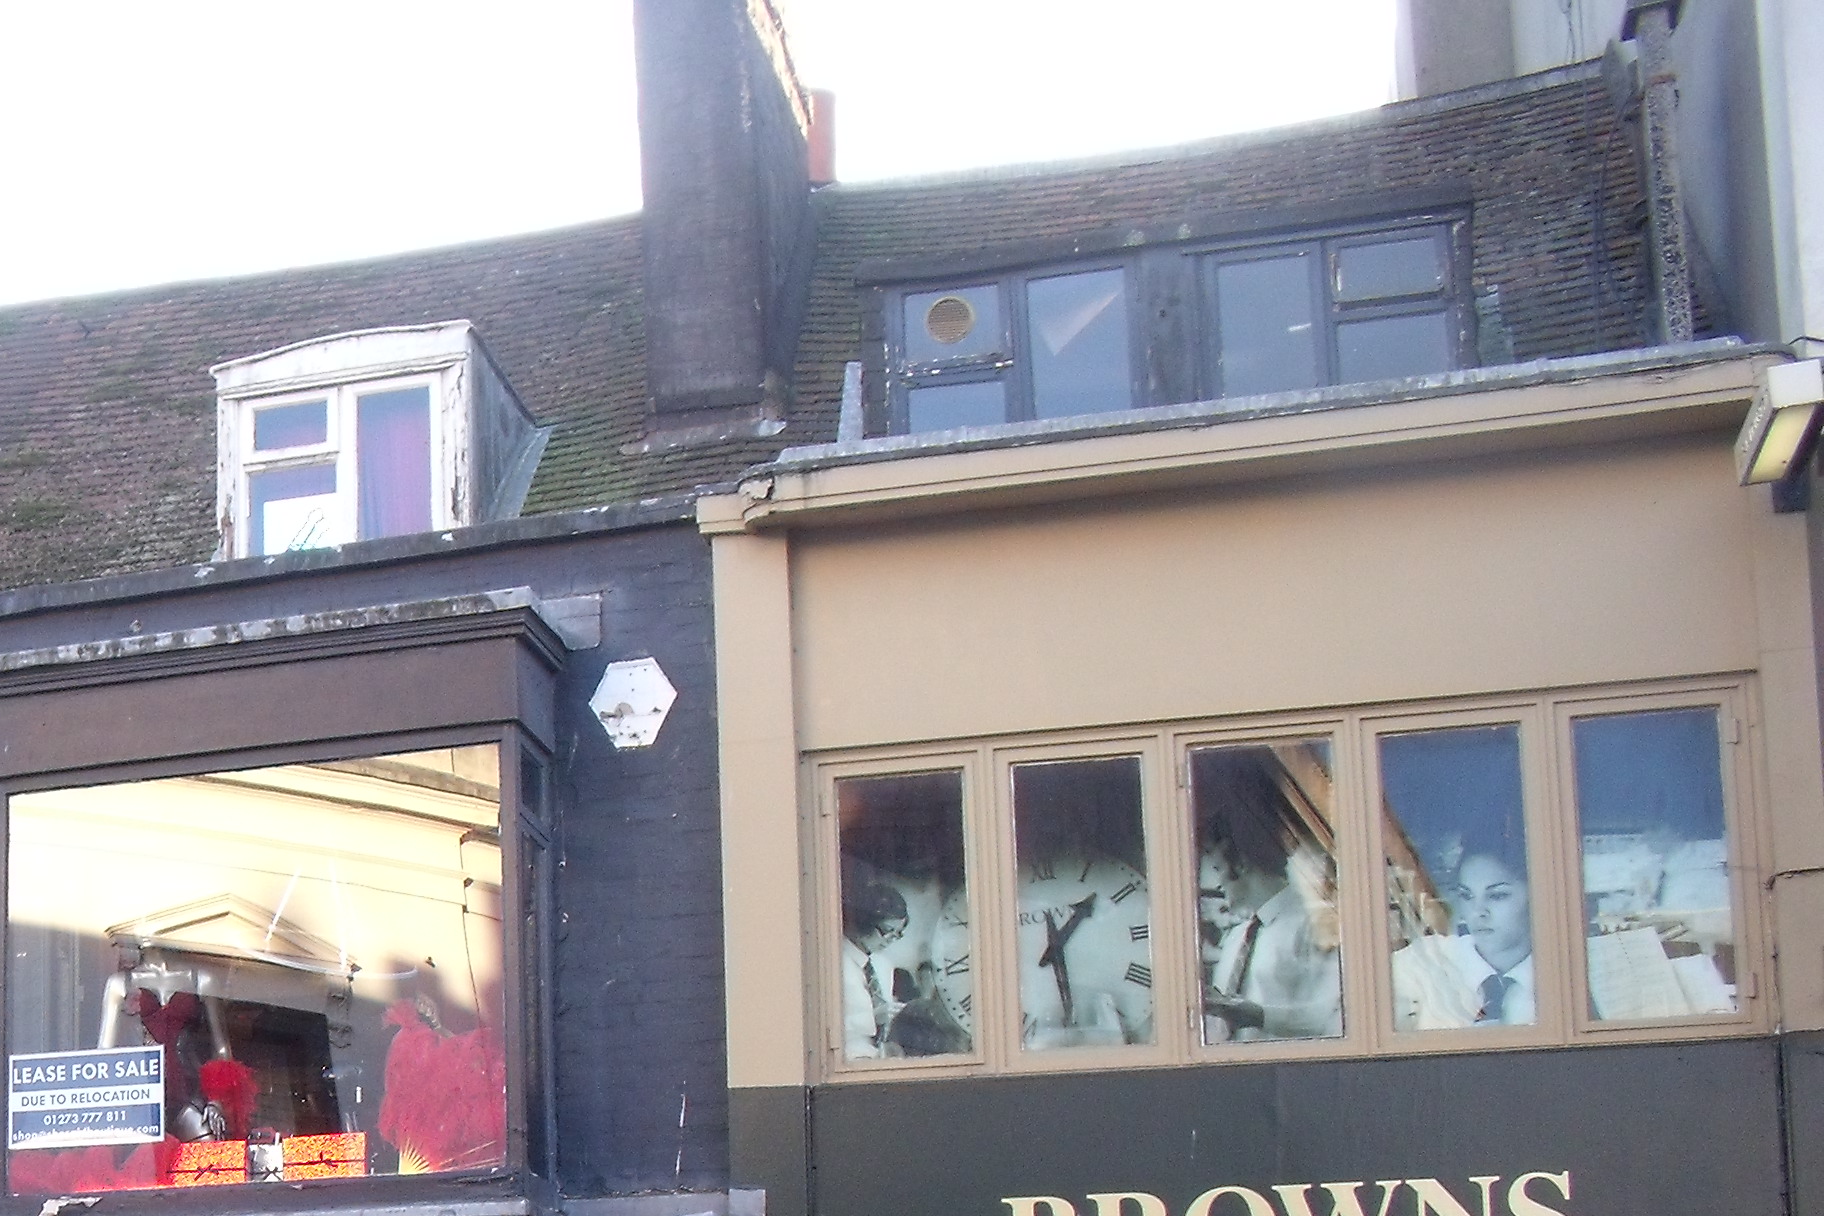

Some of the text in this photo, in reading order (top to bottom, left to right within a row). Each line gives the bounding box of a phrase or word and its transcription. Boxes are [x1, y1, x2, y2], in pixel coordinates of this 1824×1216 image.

[13, 1058, 159, 1084] LEASE FOR SALE
[21, 1088, 151, 1107] DUE TO RELOCATION
[43, 1110, 126, 1126] 01273 777 811
